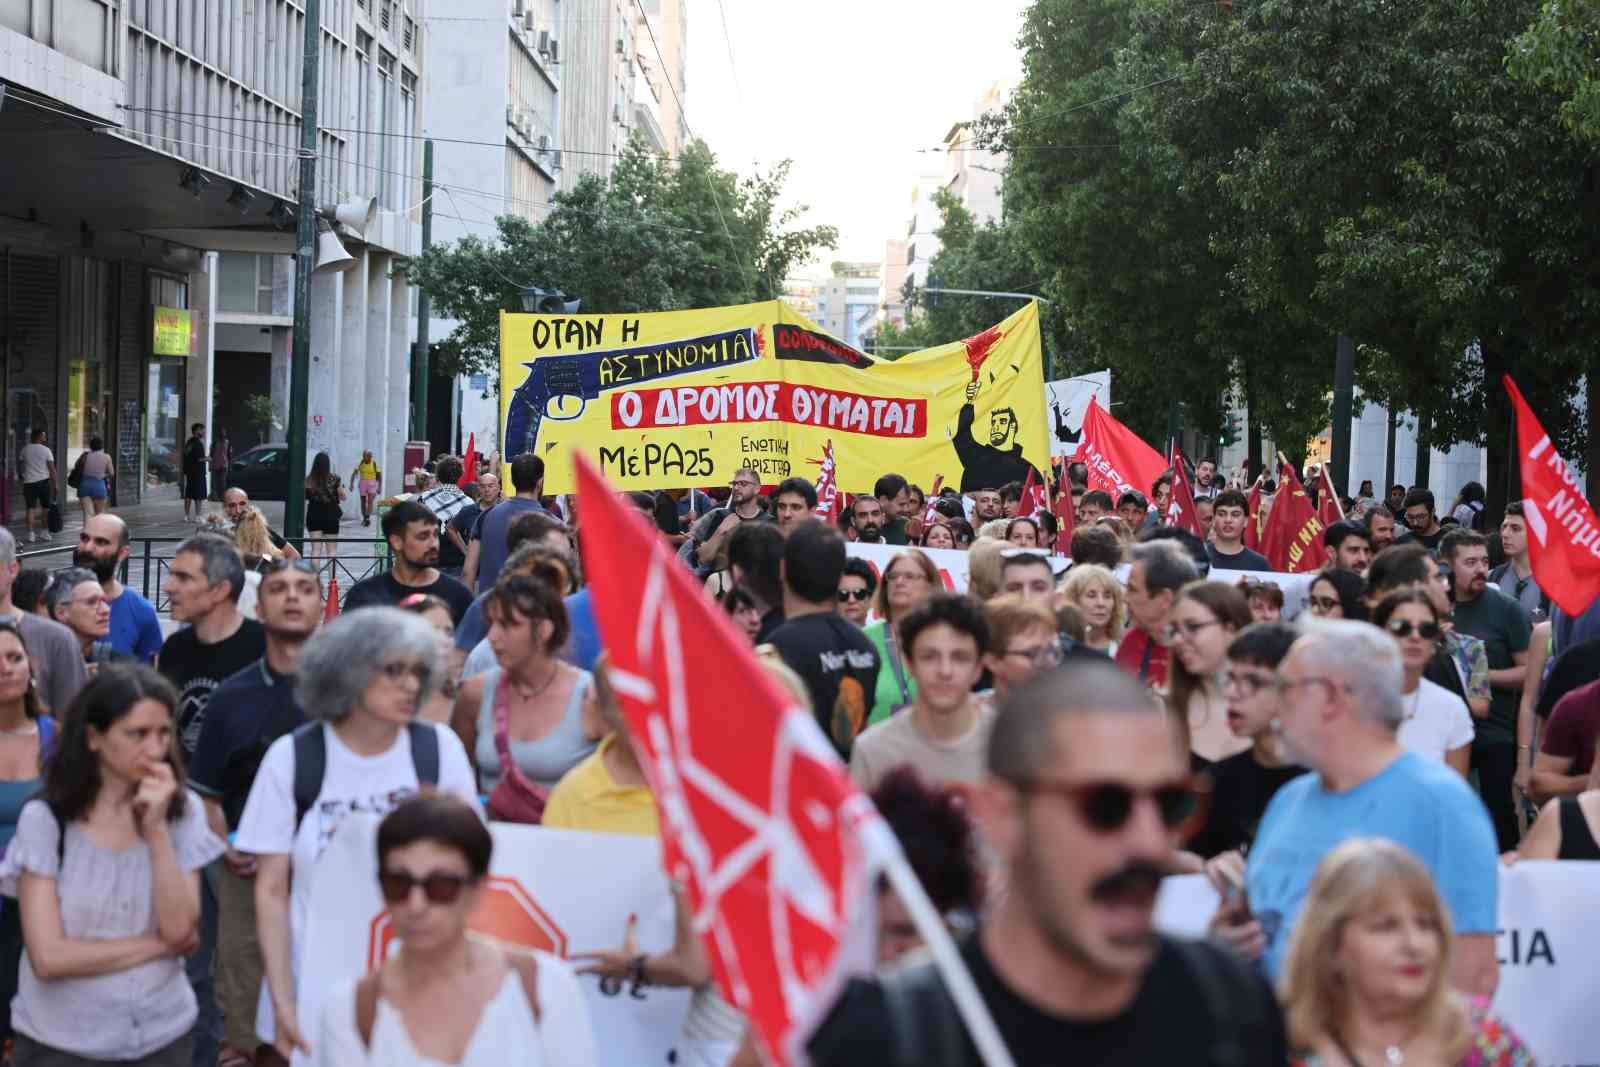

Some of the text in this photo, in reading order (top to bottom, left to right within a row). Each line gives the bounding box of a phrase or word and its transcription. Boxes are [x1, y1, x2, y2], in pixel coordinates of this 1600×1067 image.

[532, 318, 640, 350] ΟΤΑΝ Η
[599, 334, 751, 385] ΑΣΤΥΝΟΜΙΑ
[617, 383, 917, 434] Ο ΔΡΟΜΟΣ ΘΥΜΑΤΑΙ
[742, 457, 791, 477] ΑΡΙΣΤΑ
